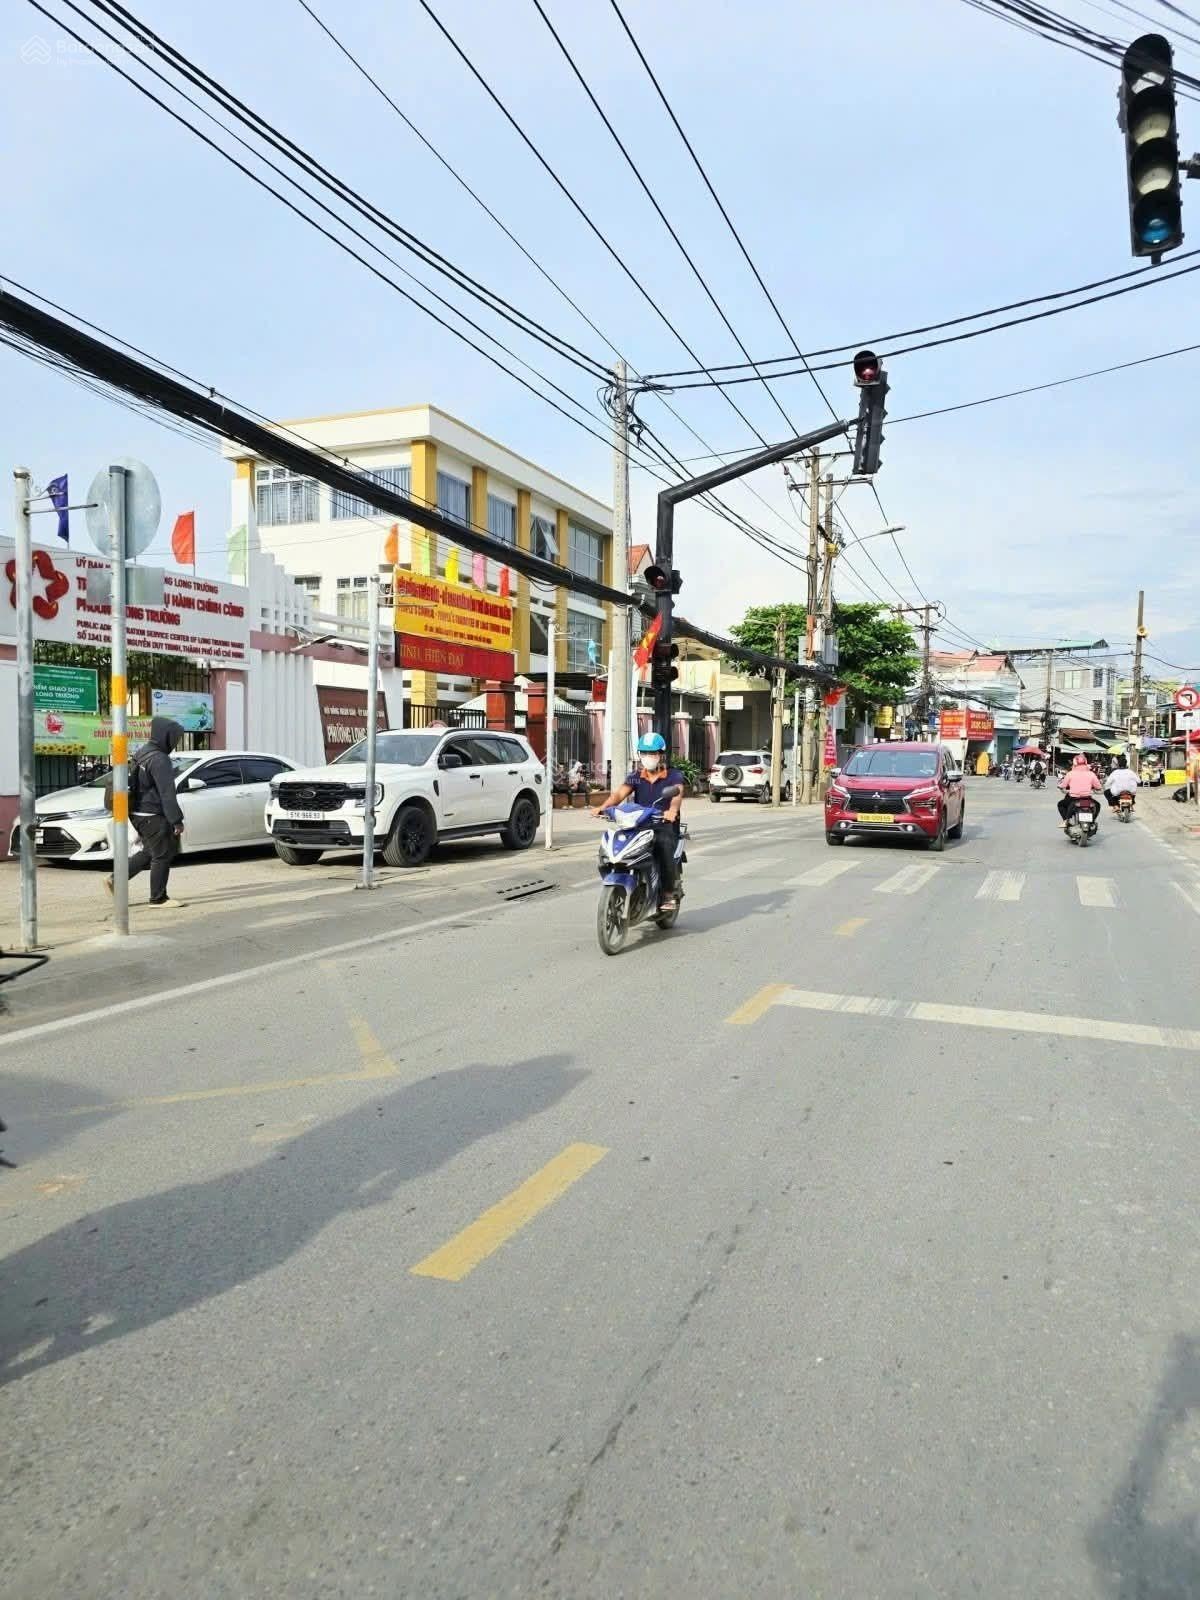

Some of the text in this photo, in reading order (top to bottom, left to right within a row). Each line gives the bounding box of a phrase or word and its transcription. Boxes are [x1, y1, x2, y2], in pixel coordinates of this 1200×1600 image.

[174, 578, 192, 590] LONG
[193, 582, 219, 594] TRƯỜNG
[171, 593, 196, 610] HÀNH
[196, 598, 222, 614] CHÍNH
[223, 602, 245, 618] CÔNG
[144, 607, 181, 626] TRƯỜNG
